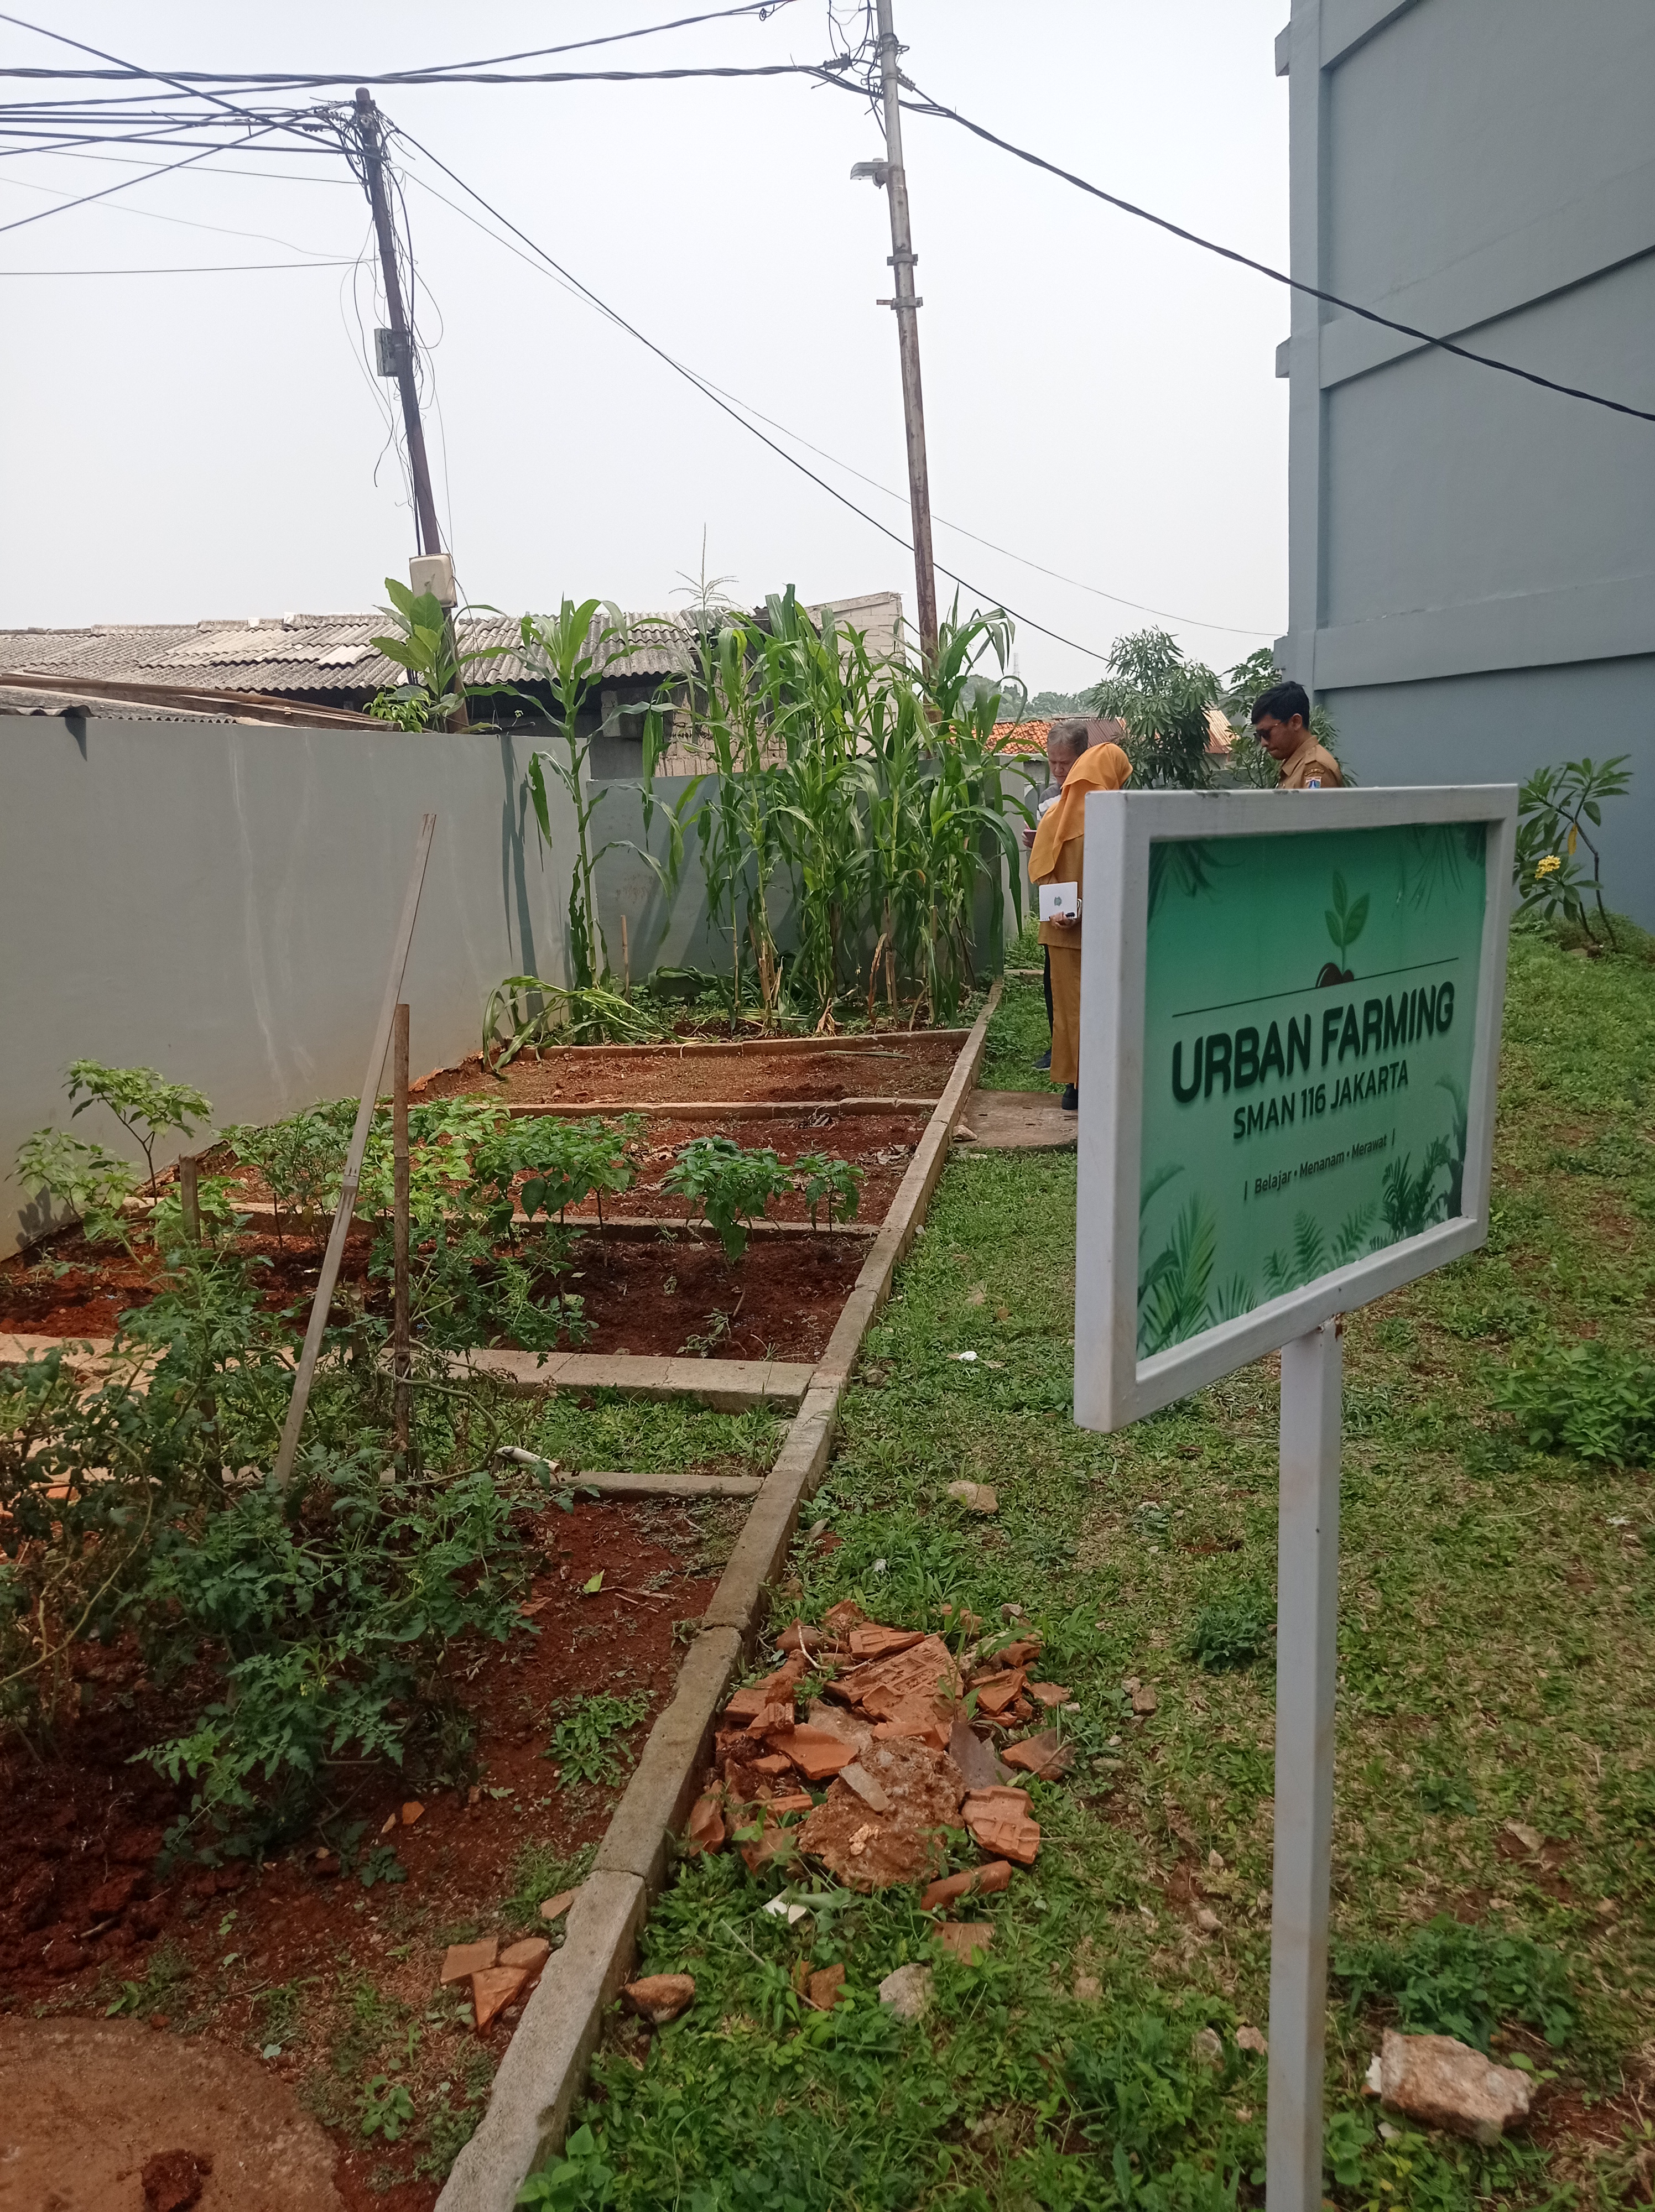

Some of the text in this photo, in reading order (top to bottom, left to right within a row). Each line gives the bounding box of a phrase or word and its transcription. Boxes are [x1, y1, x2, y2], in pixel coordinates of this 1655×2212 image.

[1172, 981, 1455, 1103] URBAN FARMING
[1233, 1060, 1408, 1139] SMAN 116 JAKARTA
[1255, 1134, 1387, 1194] Belajar Menanam Merawat
